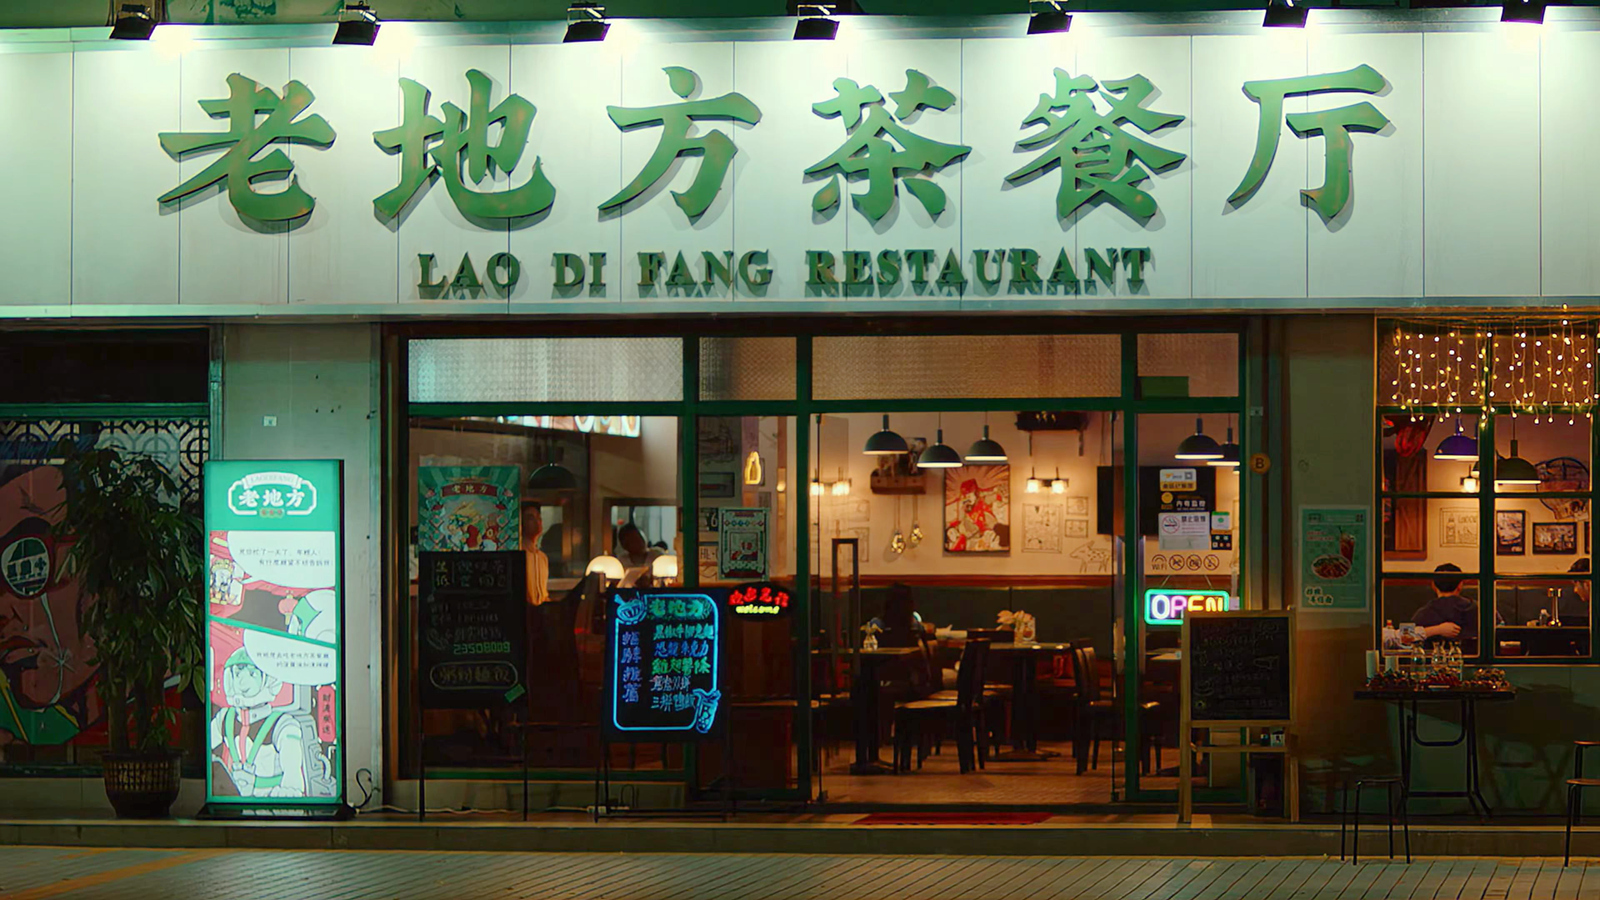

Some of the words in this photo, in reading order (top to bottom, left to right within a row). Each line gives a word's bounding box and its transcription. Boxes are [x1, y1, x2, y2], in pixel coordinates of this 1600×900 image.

[157, 64, 1391, 228] 老地方茶餐厅
[417, 251, 521, 291] LAO
[553, 252, 607, 291] DI
[637, 249, 775, 290] FANG
[805, 246, 1150, 289] RESTAURANT
[1255, 458, 1265, 469] B
[238, 488, 305, 508] 老地方
[1151, 594, 1223, 620] OPEN
